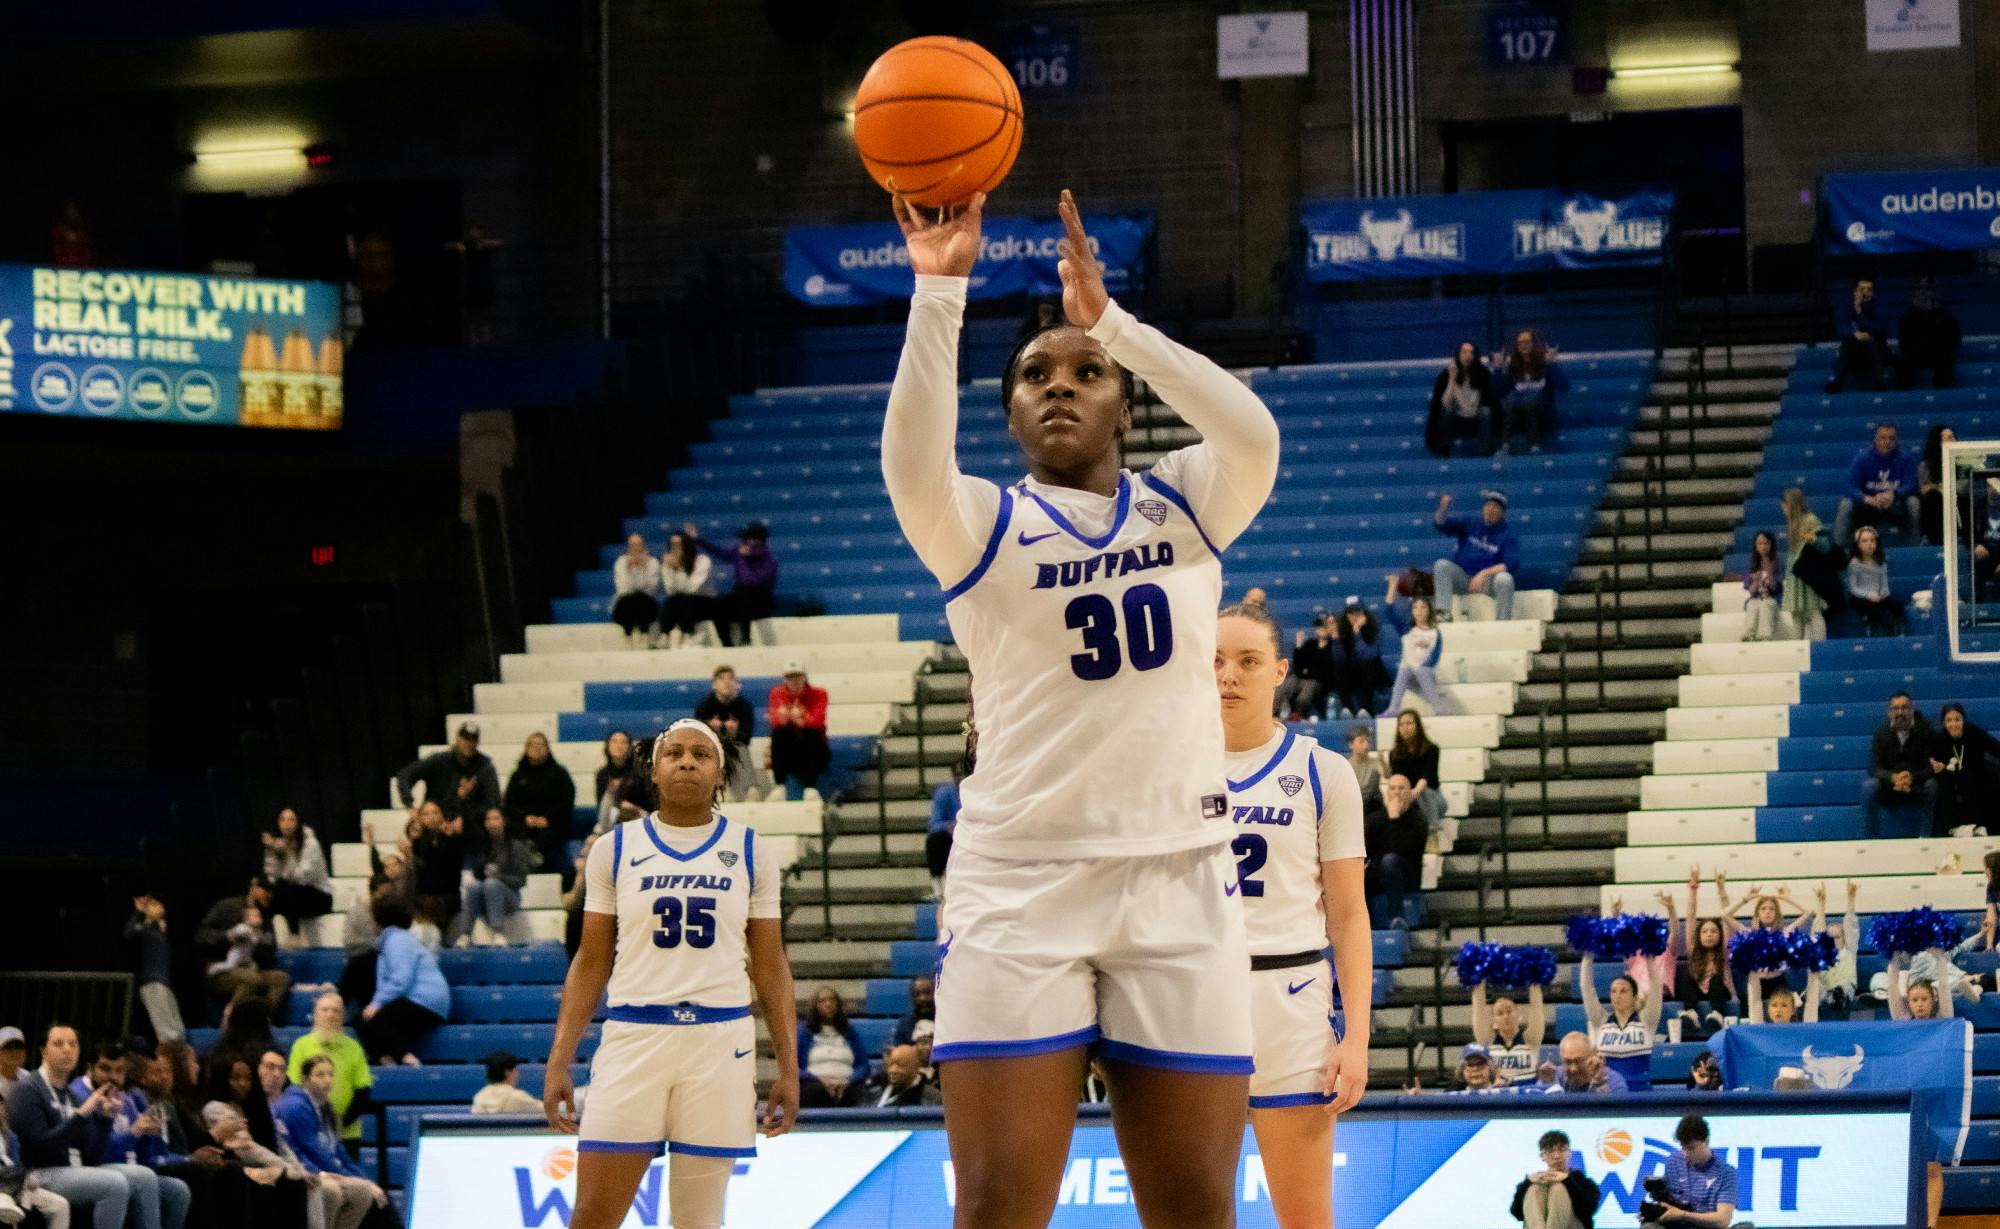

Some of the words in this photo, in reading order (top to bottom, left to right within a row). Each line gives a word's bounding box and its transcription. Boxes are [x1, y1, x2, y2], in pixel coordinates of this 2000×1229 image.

[1500, 30, 1556, 60] 107
[1015, 56, 1068, 86] 106
[1882, 184, 2000, 214] audenb
[33, 268, 202, 308] RECOVER
[209, 280, 305, 315] WITH
[33, 300, 131, 333] REAL
[136, 306, 233, 342] MILK.
[33, 332, 134, 360] LACTOSE
[138, 338, 200, 363] FREE.
[1031, 542, 1174, 589] BUFFALO
[1065, 583, 1173, 681] 30
[1231, 806, 1294, 826] FALO
[638, 875, 732, 892] BUFFALO
[652, 896, 716, 949] 35
